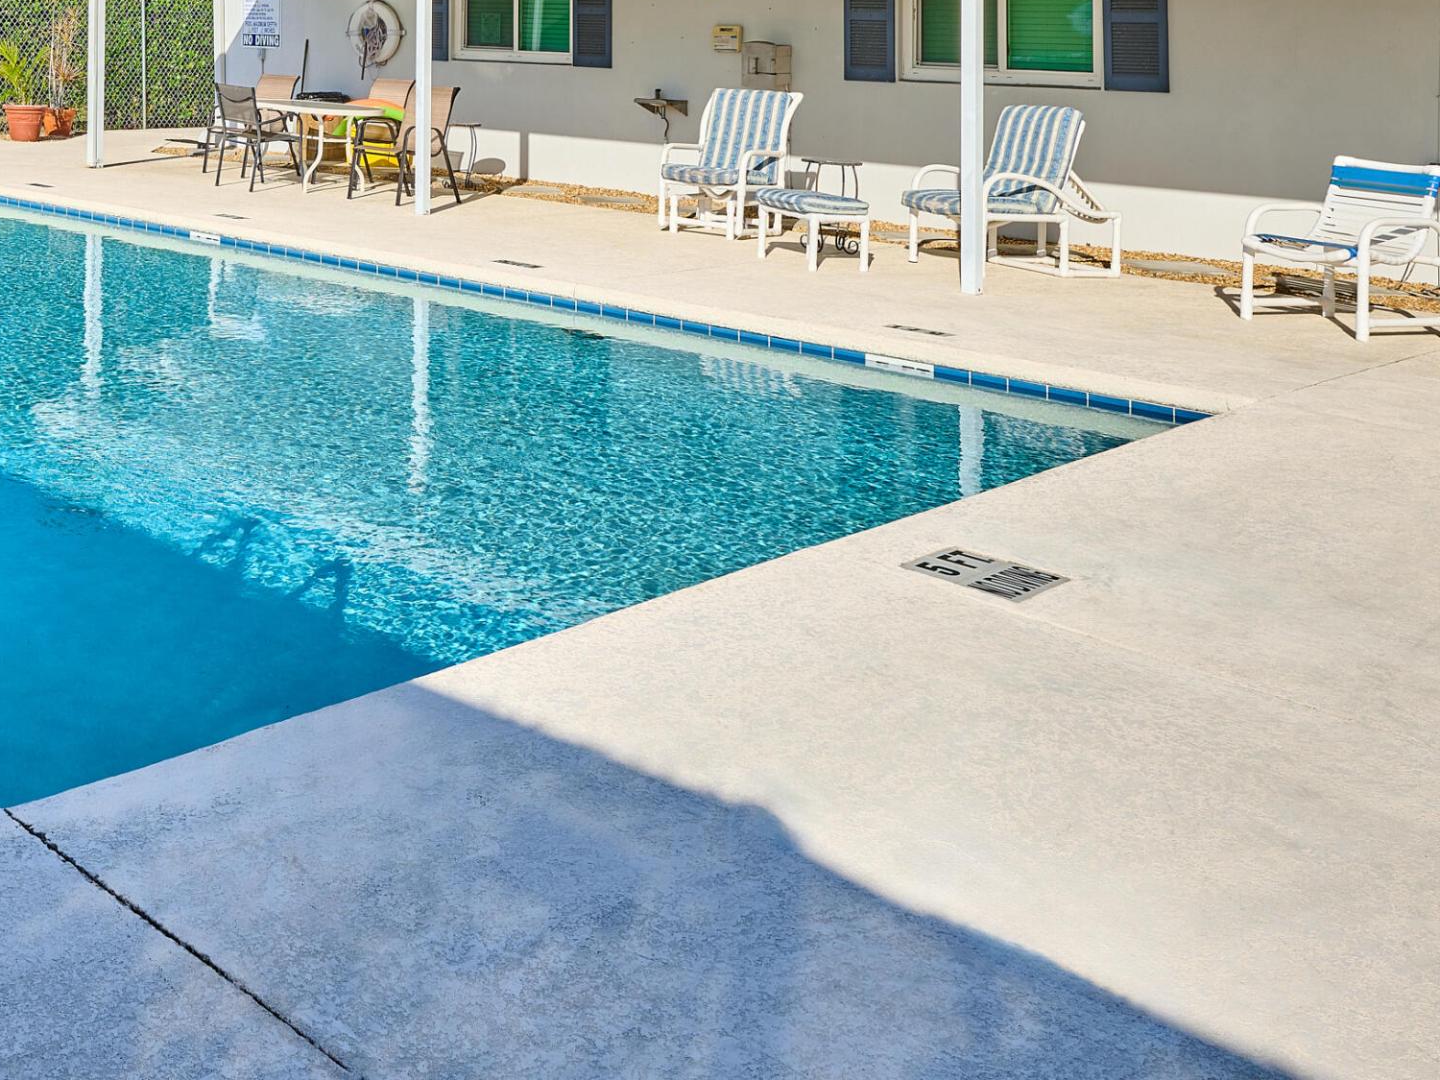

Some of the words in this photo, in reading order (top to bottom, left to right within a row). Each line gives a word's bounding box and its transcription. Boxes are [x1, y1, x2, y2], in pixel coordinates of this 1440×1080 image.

[243, 35, 253, 45] NO
[255, 35, 279, 46] DIVING
[936, 550, 995, 569] FT
[915, 561, 961, 577] 5
